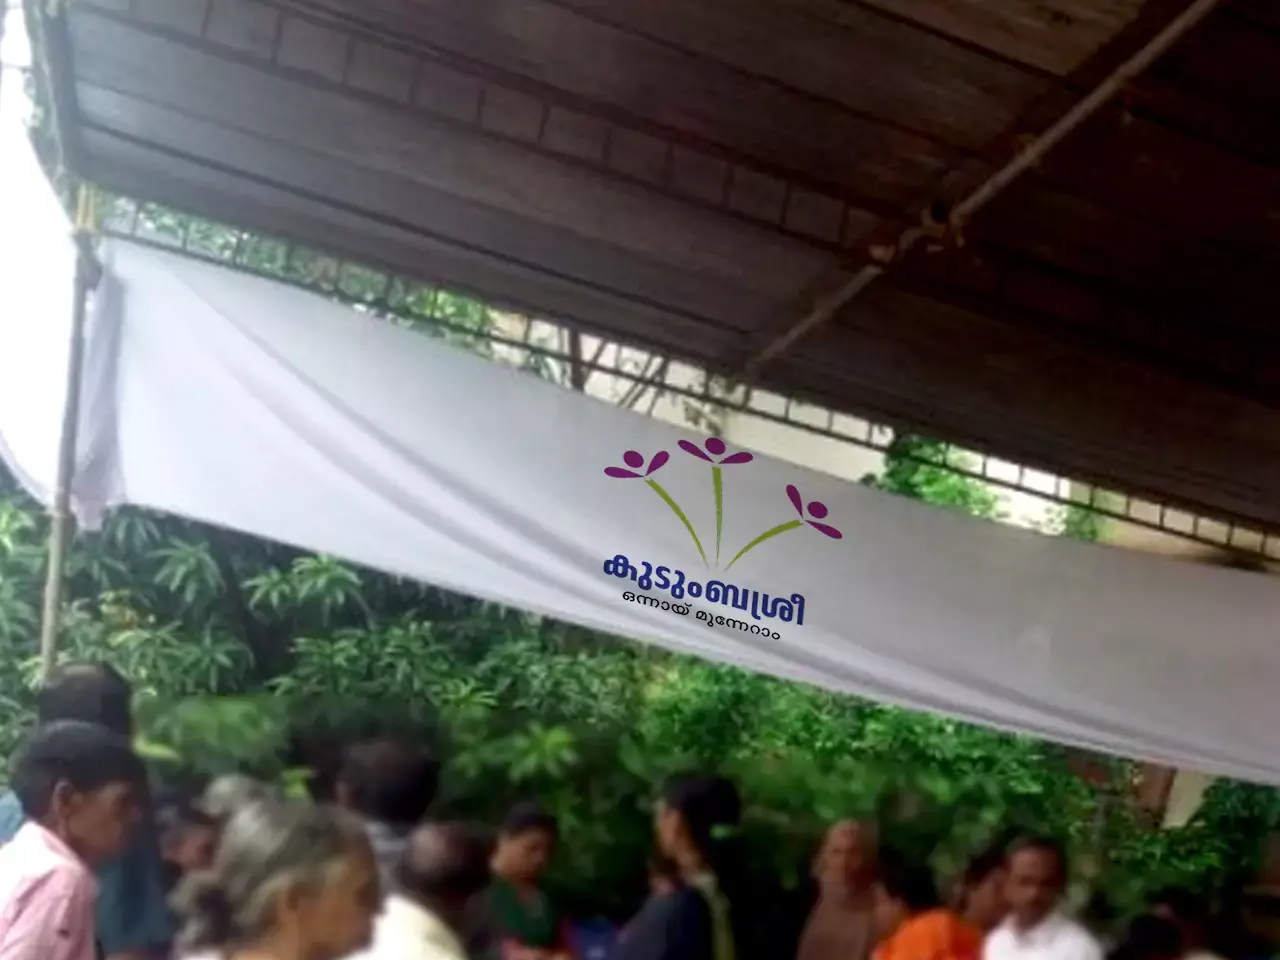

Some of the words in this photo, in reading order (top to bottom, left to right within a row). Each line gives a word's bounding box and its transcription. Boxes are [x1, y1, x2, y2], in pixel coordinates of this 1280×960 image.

[603, 554, 806, 626] കുടുംബശ്രീ
[622, 590, 692, 616] ഒന്നായ്
[695, 609, 781, 640] മുന്നേറാം
